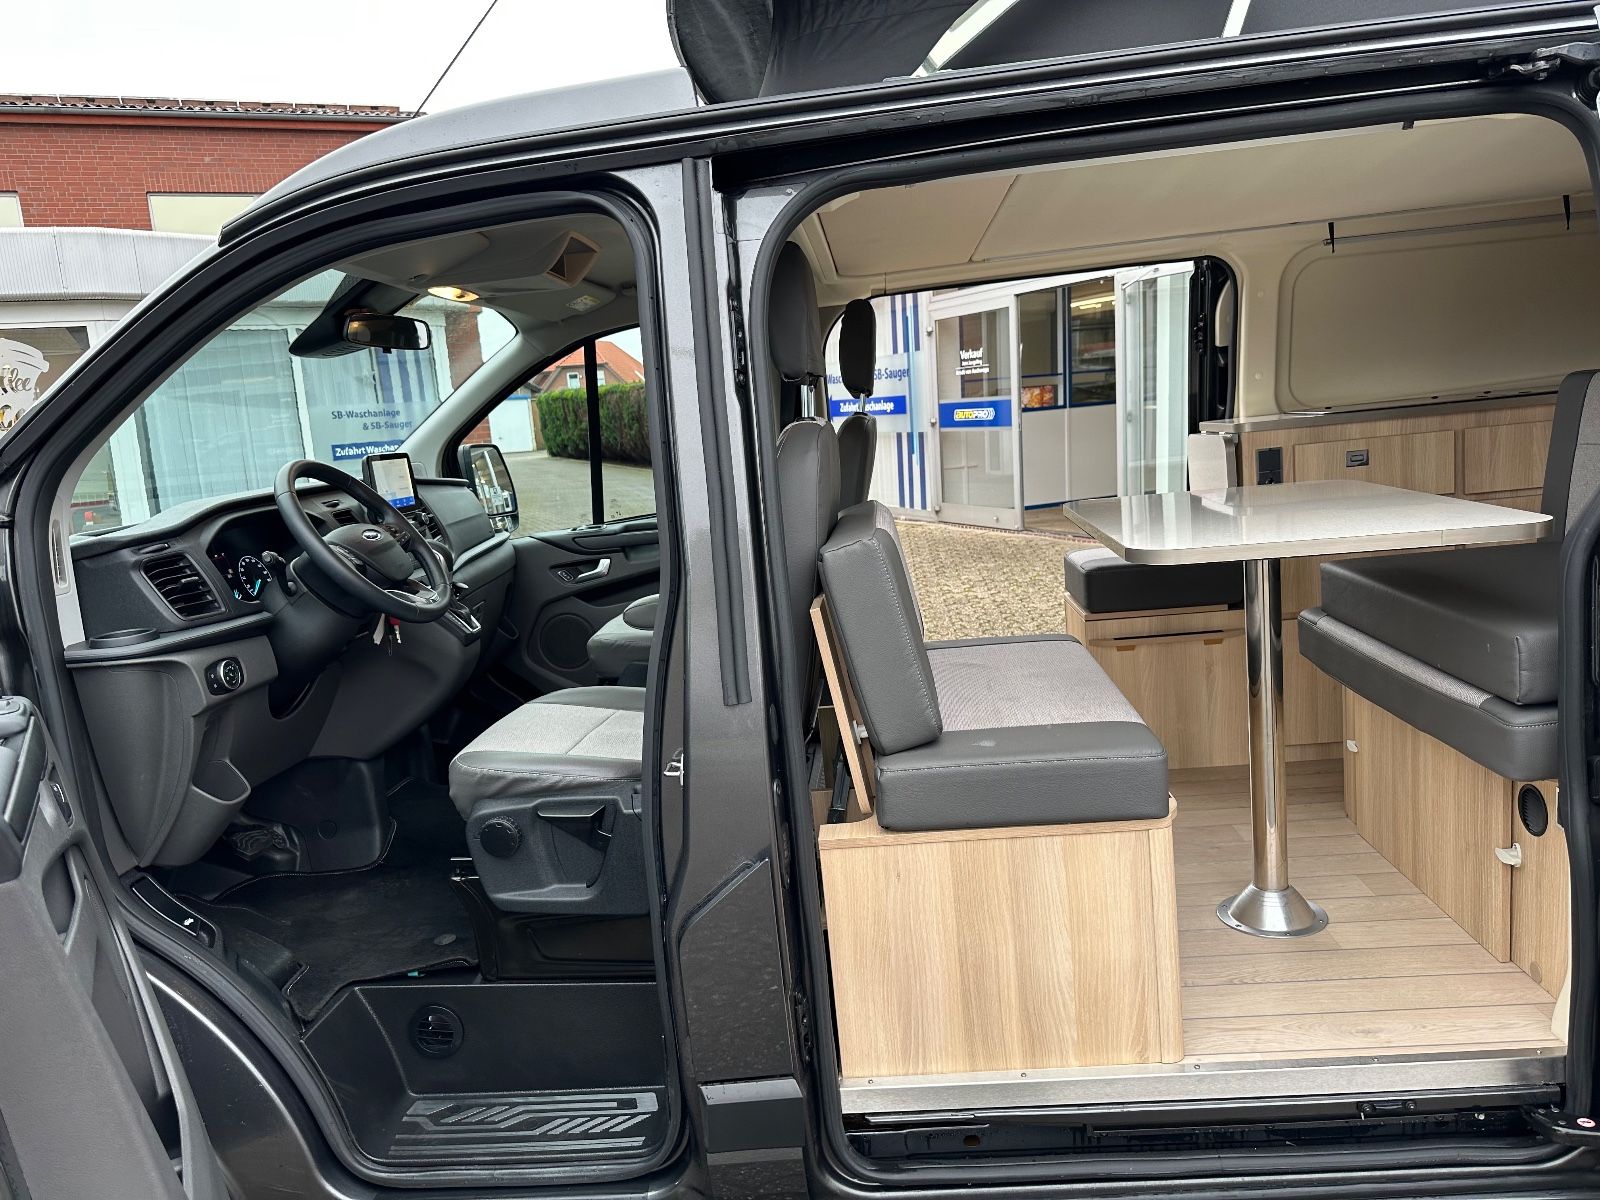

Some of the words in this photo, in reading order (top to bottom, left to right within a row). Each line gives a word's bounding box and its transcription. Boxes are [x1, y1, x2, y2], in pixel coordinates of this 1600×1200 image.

[960, 347, 983, 359] Verkauf
[840, 402, 859, 412] Zufahrt
[331, 409, 401, 420] SB-Waschanlage
[362, 422, 369, 430] &
[335, 446, 366, 457] Zufahrt
